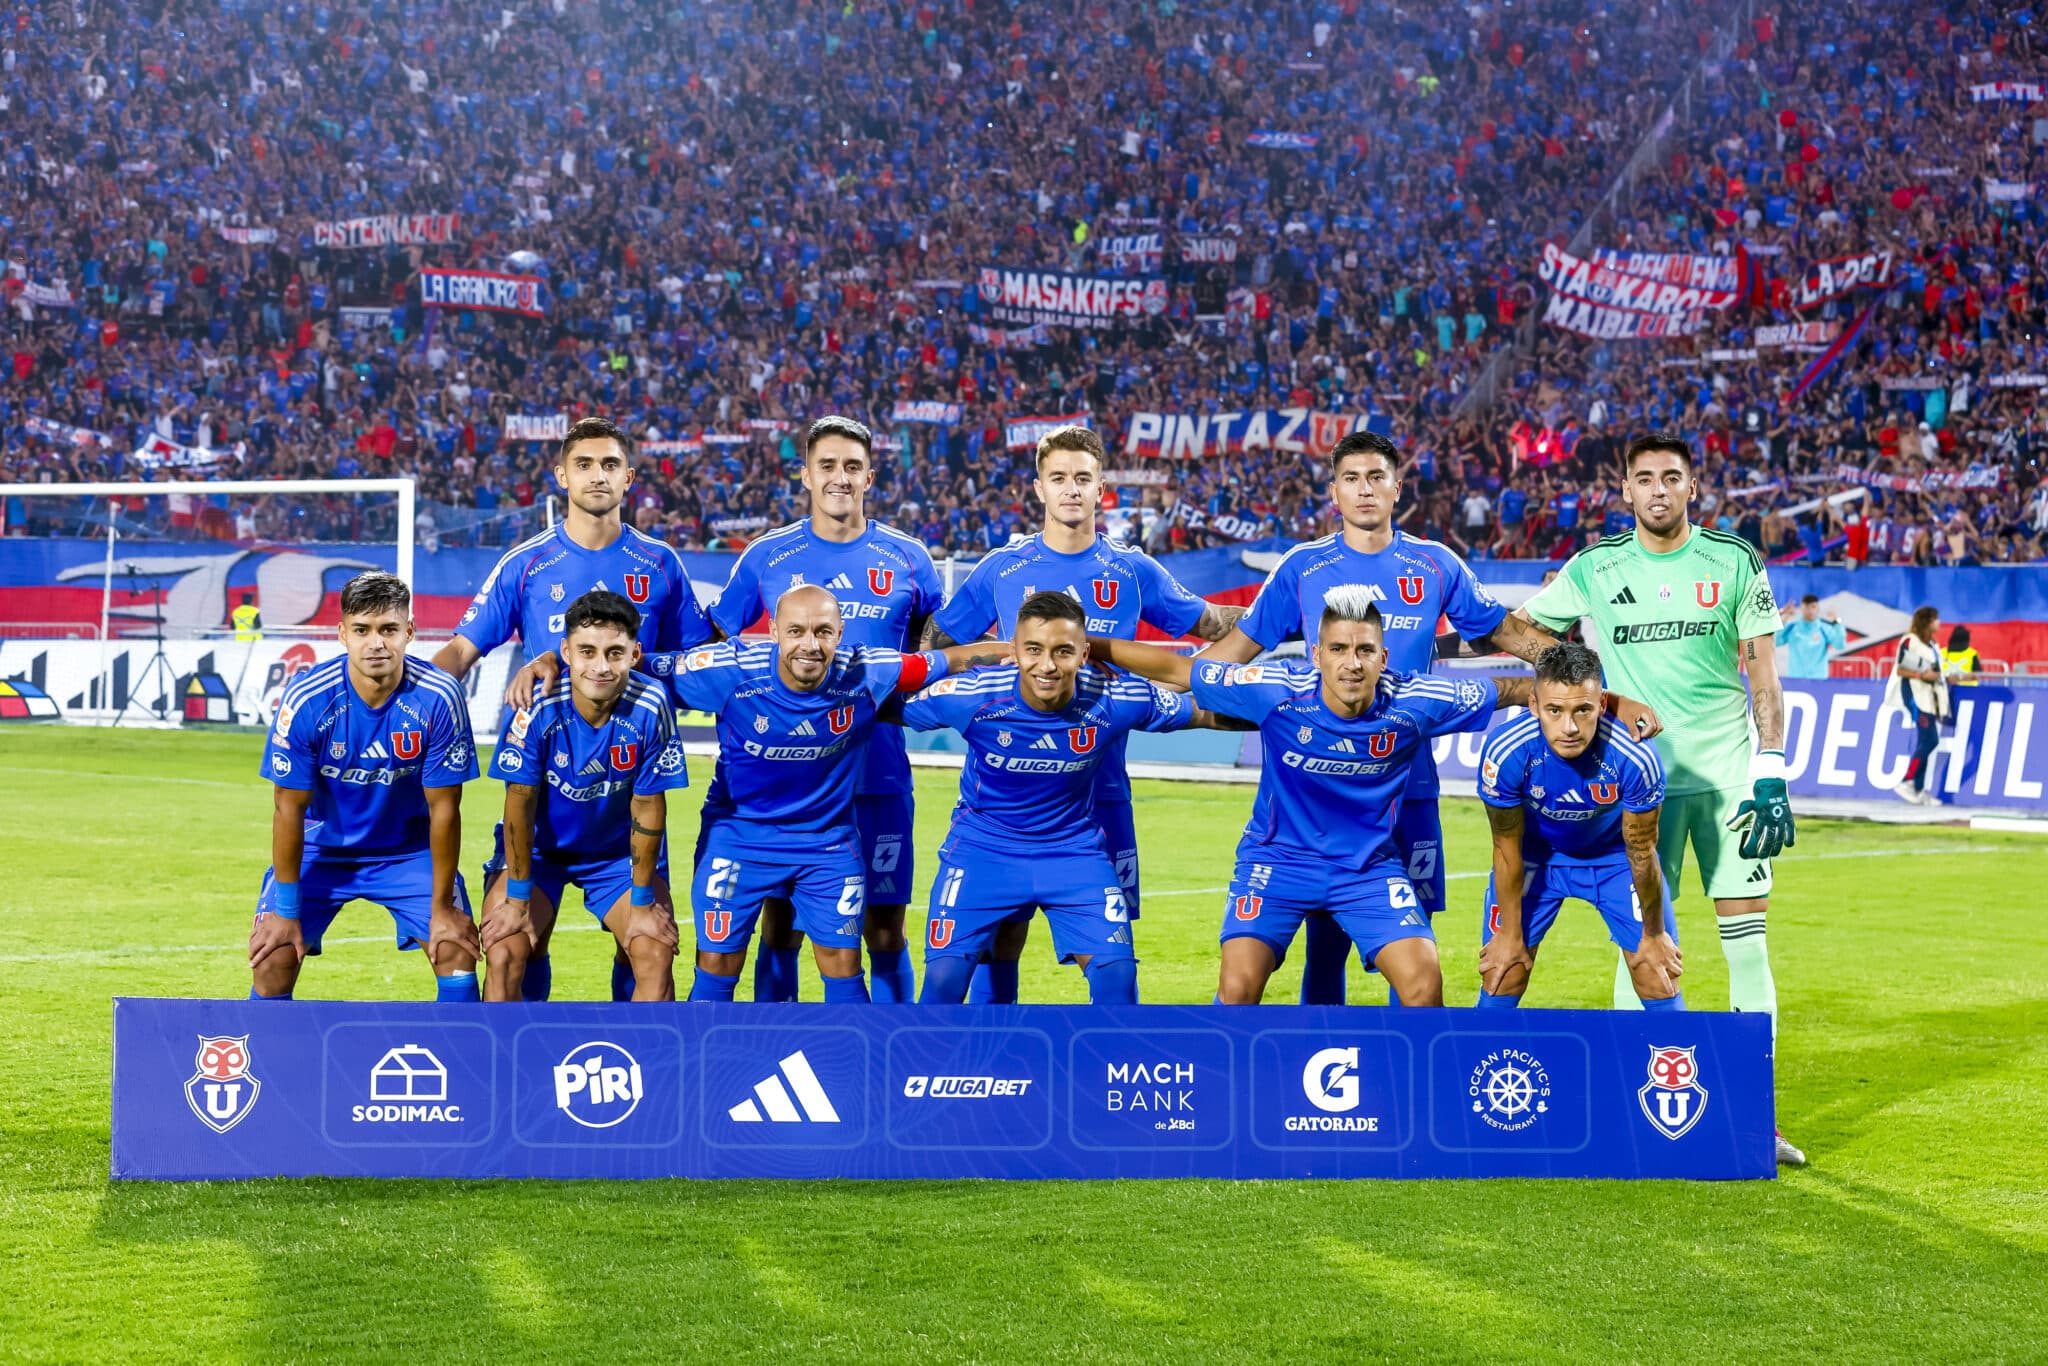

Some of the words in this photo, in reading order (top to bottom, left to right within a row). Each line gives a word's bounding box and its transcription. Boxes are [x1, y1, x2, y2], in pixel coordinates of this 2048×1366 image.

[421, 273, 447, 302] LA
[624, 574, 649, 603] U
[867, 568, 893, 597] U
[1093, 580, 1119, 609] U
[1397, 576, 1424, 605] U
[1695, 582, 1720, 608] U
[828, 705, 854, 735] U
[391, 731, 421, 759] U
[1068, 726, 1096, 753] U
[1369, 732, 1397, 758] U
[610, 743, 638, 771] U
[1588, 783, 1619, 804] U
[1236, 896, 1262, 920] U
[705, 911, 732, 942] U
[929, 919, 955, 949] U
[1107, 1063, 1194, 1083] MACH
[1469, 1052, 1499, 1096] OCEAN
[1503, 1049, 1551, 1096] PACIFIC'S
[204, 1084, 241, 1119] U
[1107, 1090, 1194, 1111] BANK
[1656, 1093, 1690, 1126] U
[1154, 1120, 1167, 1130] de
[1178, 1119, 1194, 1130] Bci
[1284, 1117, 1378, 1132] GATORADE
[1481, 1113, 1537, 1132] RESTAURANT
